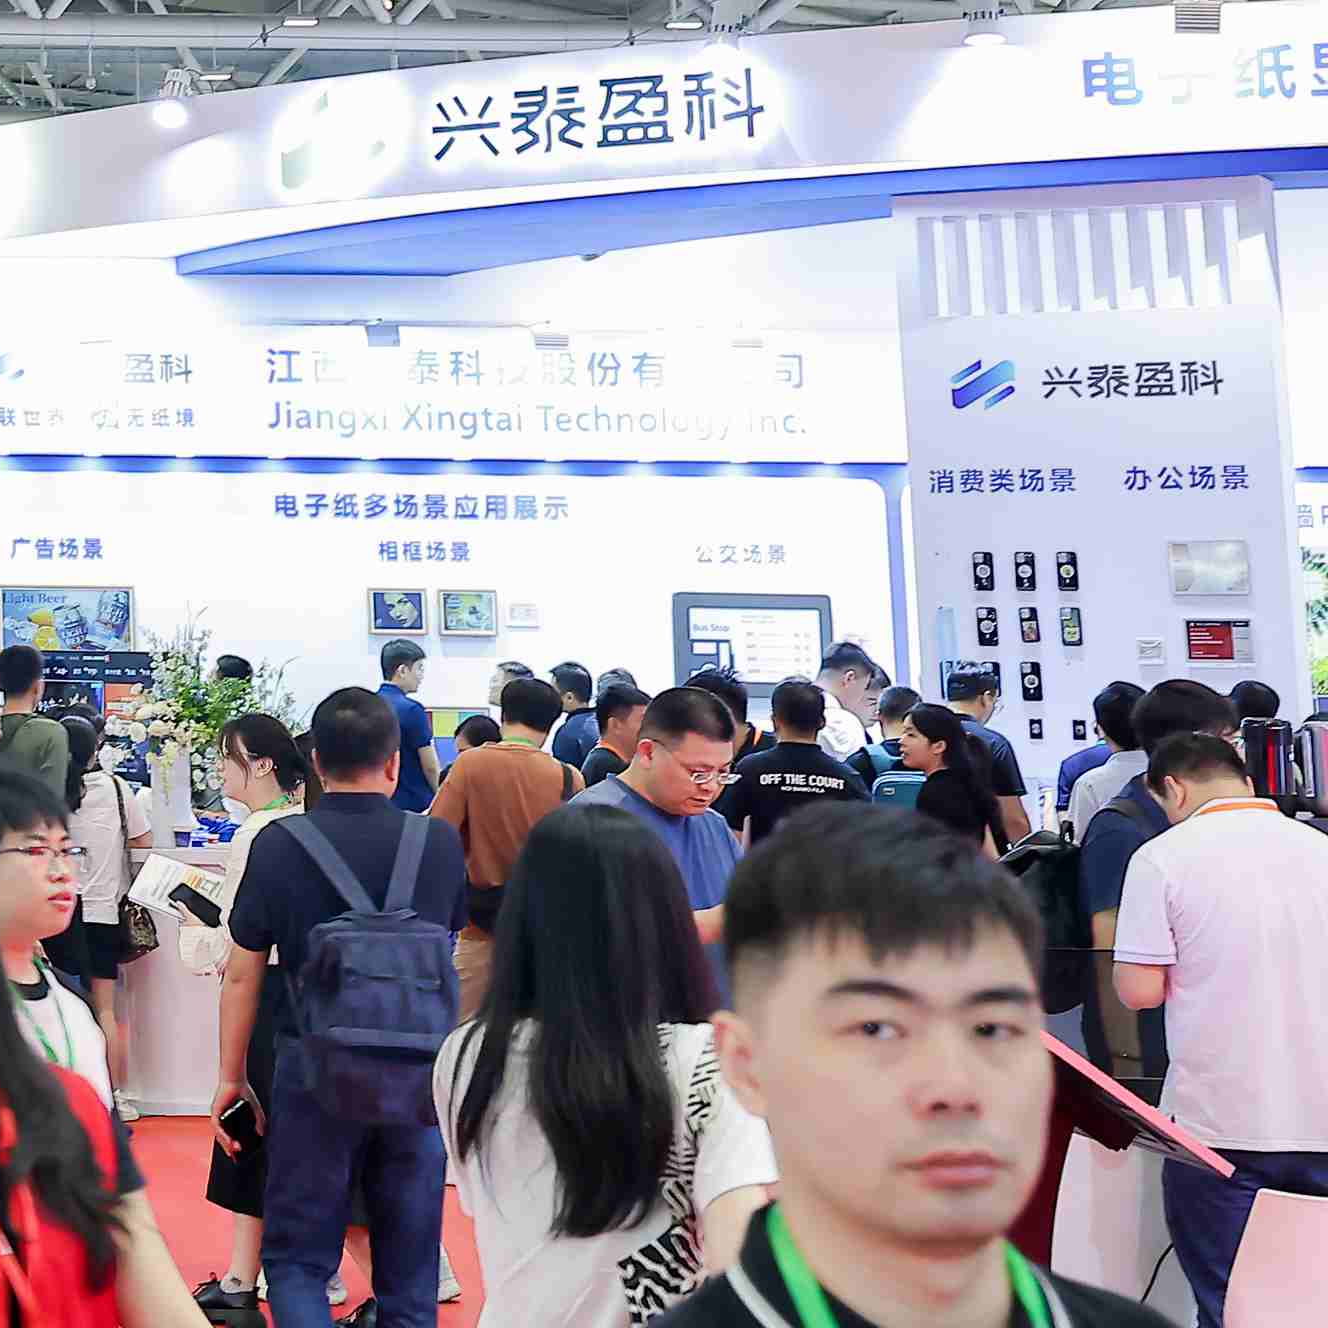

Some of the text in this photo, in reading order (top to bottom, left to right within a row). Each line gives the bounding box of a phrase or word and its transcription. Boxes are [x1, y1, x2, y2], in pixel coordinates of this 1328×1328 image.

[432, 68, 764, 160] 兴泰盈科
[1042, 361, 1223, 399] 兴泰盈科
[267, 402, 388, 439] Jiangxi
[402, 403, 522, 440] Xingtai
[929, 468, 1077, 494] 消费类场景
[1124, 465, 1250, 490] 办公场景
[273, 494, 570, 521] 电子纸多场景应用展示
[10, 537, 104, 561] 广告场景
[378, 539, 471, 562] 相框场景
[695, 543, 786, 566] 公交场景
[760, 774, 782, 785] OFF
[784, 774, 806, 785] THE
[809, 775, 844, 790] COURT
